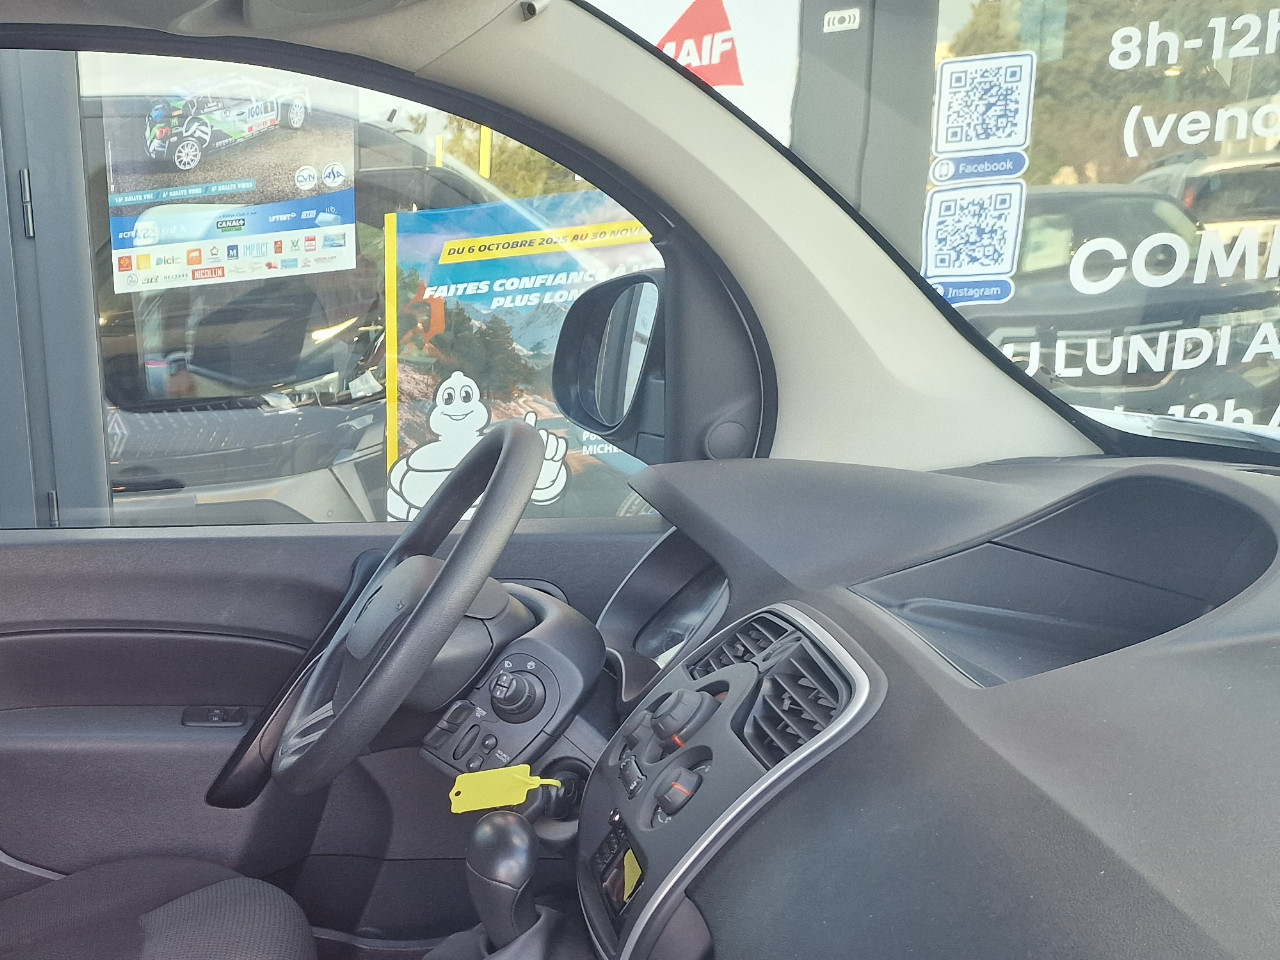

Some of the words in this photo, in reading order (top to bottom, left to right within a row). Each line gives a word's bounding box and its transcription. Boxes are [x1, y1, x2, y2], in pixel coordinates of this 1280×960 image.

[959, 158, 1014, 174] Facebook
[217, 219, 245, 229] CANAL+
[447, 246, 465, 256] DU
[467, 246, 475, 254] 6
[478, 238, 535, 253] OCTOBRE
[538, 235, 569, 246] 2025
[571, 233, 588, 243] AU
[591, 231, 607, 240] 30
[1070, 226, 1280, 295] COM
[194, 267, 224, 279] NICOLLIN
[422, 280, 491, 299] FAITES
[948, 286, 1001, 298] Instagram
[490, 293, 540, 310] PLUS
[1055, 324, 1232, 378] LUNDI
